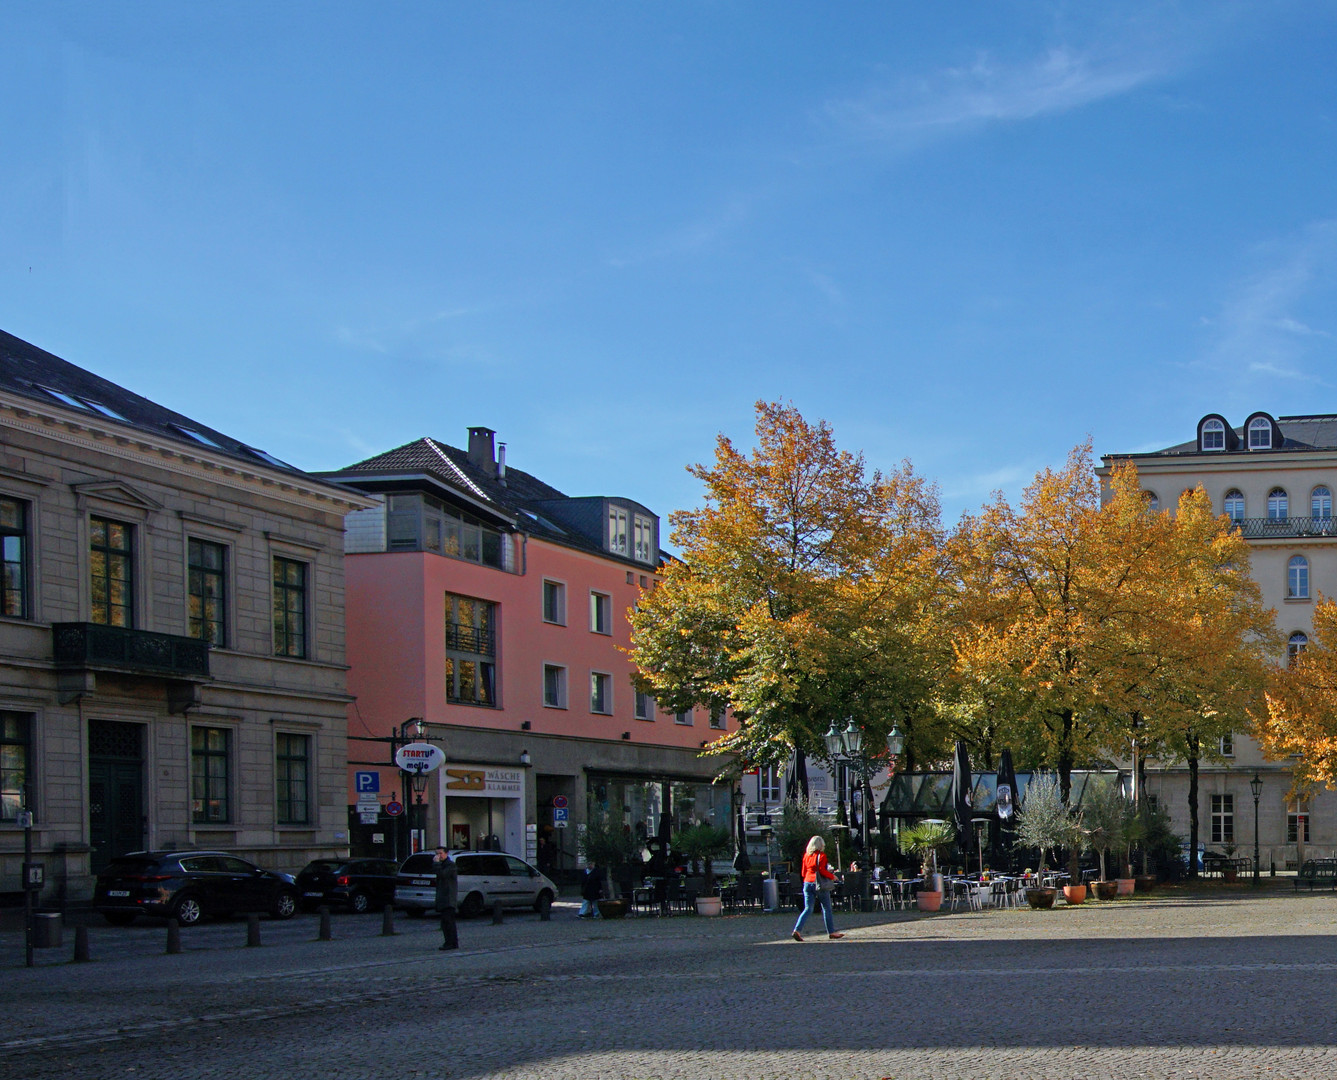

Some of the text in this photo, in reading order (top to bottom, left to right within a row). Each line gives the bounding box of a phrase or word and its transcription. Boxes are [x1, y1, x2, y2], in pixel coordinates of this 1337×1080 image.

[403, 749, 435, 758] STARTUP
[488, 769, 521, 780] WÄSCHE
[359, 774, 372, 790] P
[488, 783, 521, 791] KLAMMER
[556, 810, 566, 819] P
